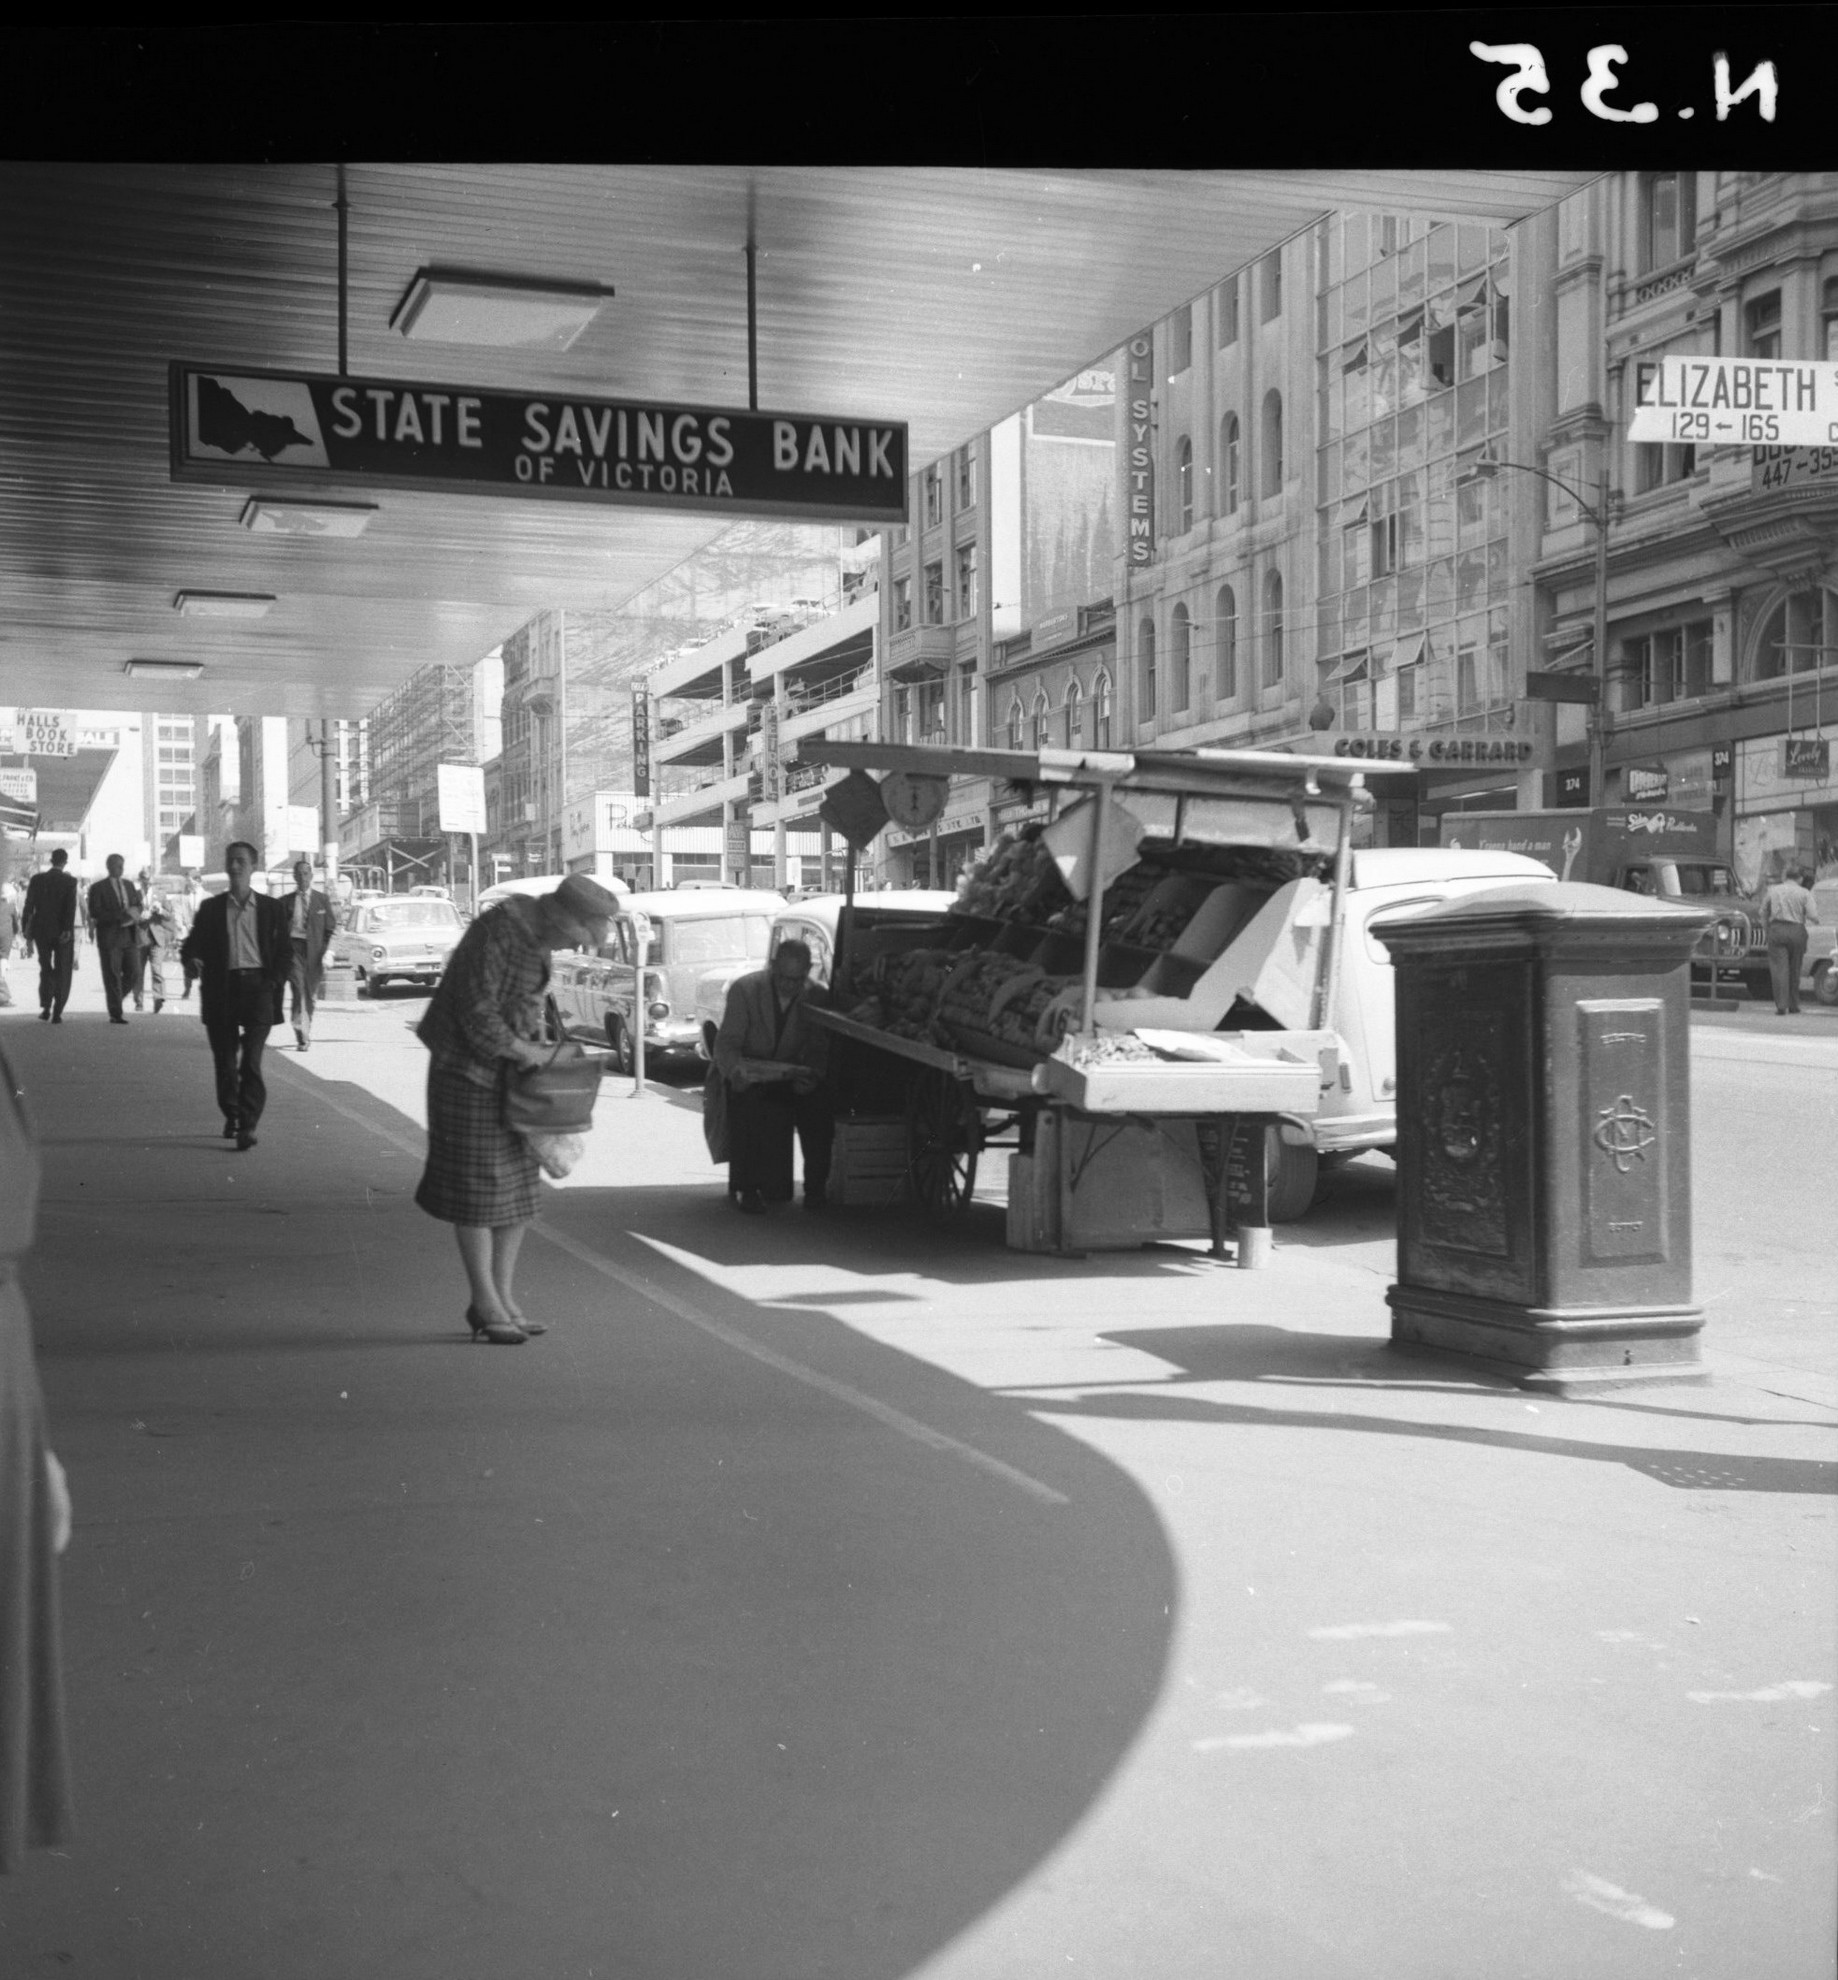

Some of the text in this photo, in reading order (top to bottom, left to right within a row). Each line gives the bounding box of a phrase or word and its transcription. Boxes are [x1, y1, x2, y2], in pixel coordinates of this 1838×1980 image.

[1636, 362, 1817, 412] ELIZABETH
[331, 386, 895, 479] STATE SAVINGS BANK
[1672, 411, 1711, 440] 129
[1742, 413, 1780, 442] 165
[514, 453, 734, 497] OF VICTORIA
[1130, 399, 1150, 561] SYSTEMS
[1762, 457, 1792, 491] 447
[17, 714, 60, 728] HALLS
[26, 727, 67, 741] BOOK
[634, 692, 648, 778] PARKING
[29, 741, 74, 754] STORE
[767, 708, 778, 793] PETROL
[1333, 738, 1533, 762] COLES & GARRARD
